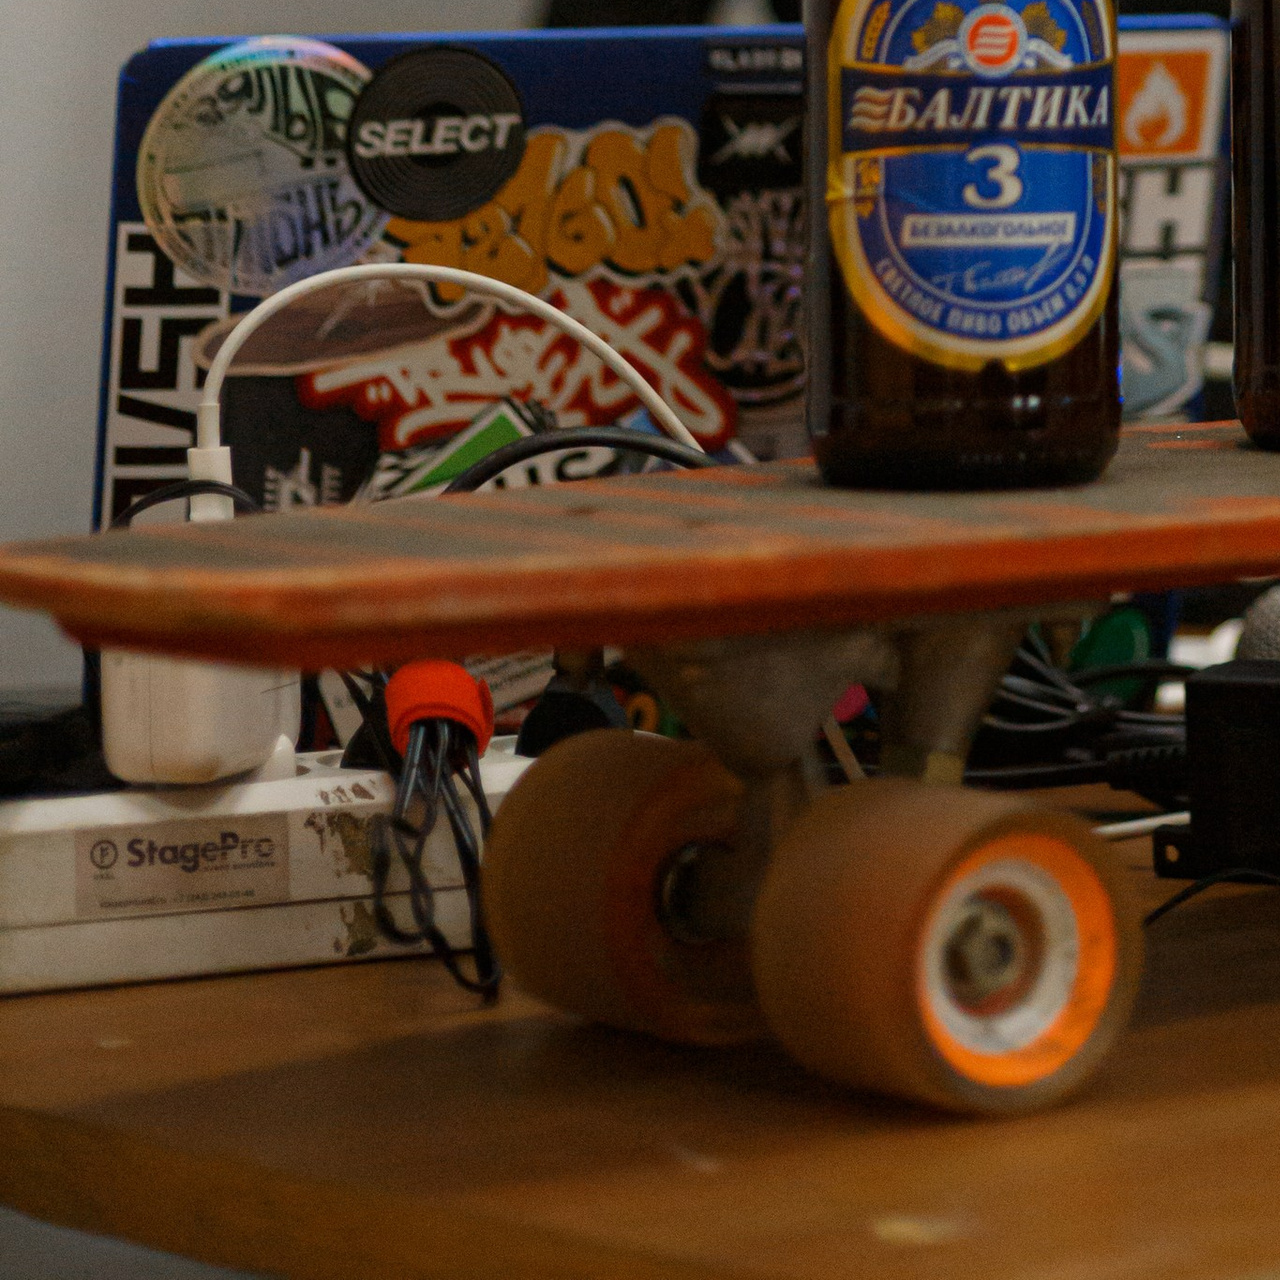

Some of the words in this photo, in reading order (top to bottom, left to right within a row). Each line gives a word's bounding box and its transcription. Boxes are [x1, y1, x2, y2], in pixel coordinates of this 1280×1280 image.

[887, 85, 1110, 131] БАЛТИКА
[355, 113, 521, 158] SELECT
[963, 146, 1023, 209] 3
[949, 302, 1001, 335] ПИВО
[127, 832, 275, 873] StagePro
